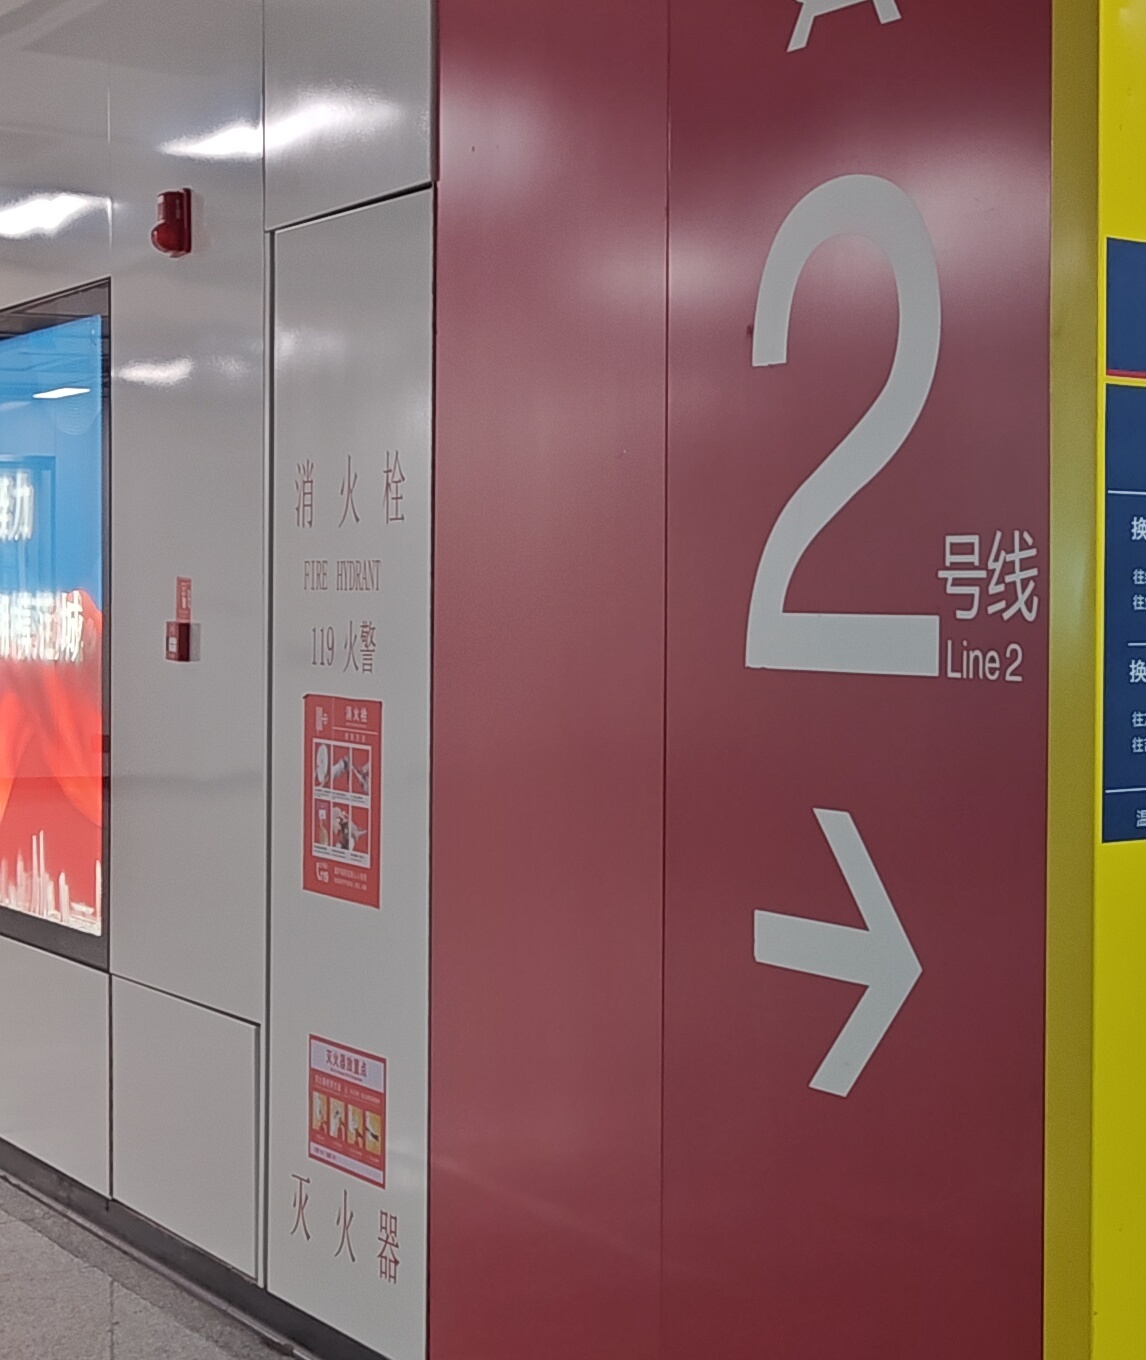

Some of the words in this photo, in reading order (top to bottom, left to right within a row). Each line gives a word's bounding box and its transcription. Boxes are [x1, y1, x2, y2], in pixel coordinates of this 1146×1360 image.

[745, 174, 942, 676] 2
[938, 530, 1039, 622] 号线
[294, 449, 406, 528] 消火栓
[303, 559, 328, 591] FIRE
[336, 559, 381, 591] HYDRANT
[311, 626, 335, 666] 119
[343, 620, 376, 675] 火警
[946, 639, 1000, 680] Line
[1004, 643, 1024, 682] 2
[290, 1173, 400, 1285] 灭火器
